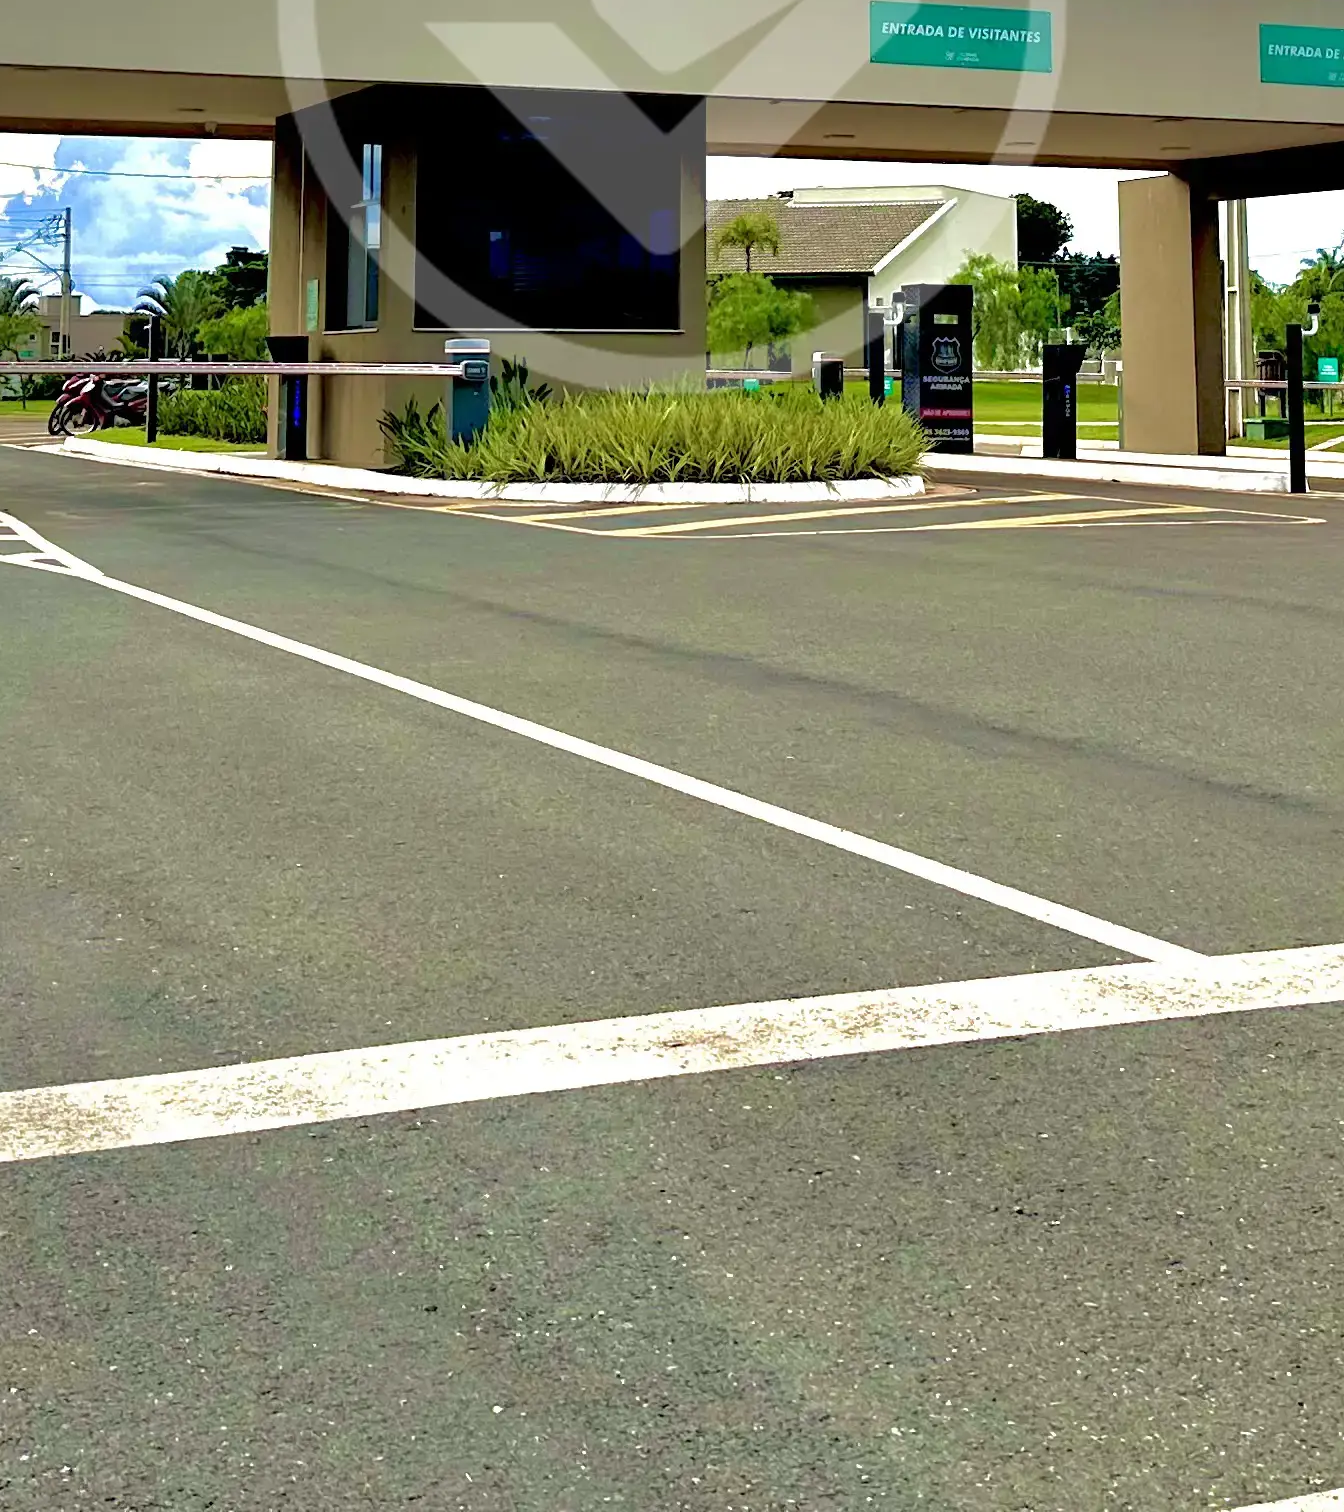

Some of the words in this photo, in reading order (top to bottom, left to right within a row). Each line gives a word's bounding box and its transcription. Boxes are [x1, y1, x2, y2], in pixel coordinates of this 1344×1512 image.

[881, 21, 943, 37] ENTRADA
[947, 26, 965, 39] DE
[968, 28, 1041, 43] VISITANTES
[1267, 44, 1323, 59] ENTRADA
[1325, 48, 1340, 60] DE
[922, 376, 970, 384] SEGURANÇA
[930, 383, 963, 391] ARMADA
